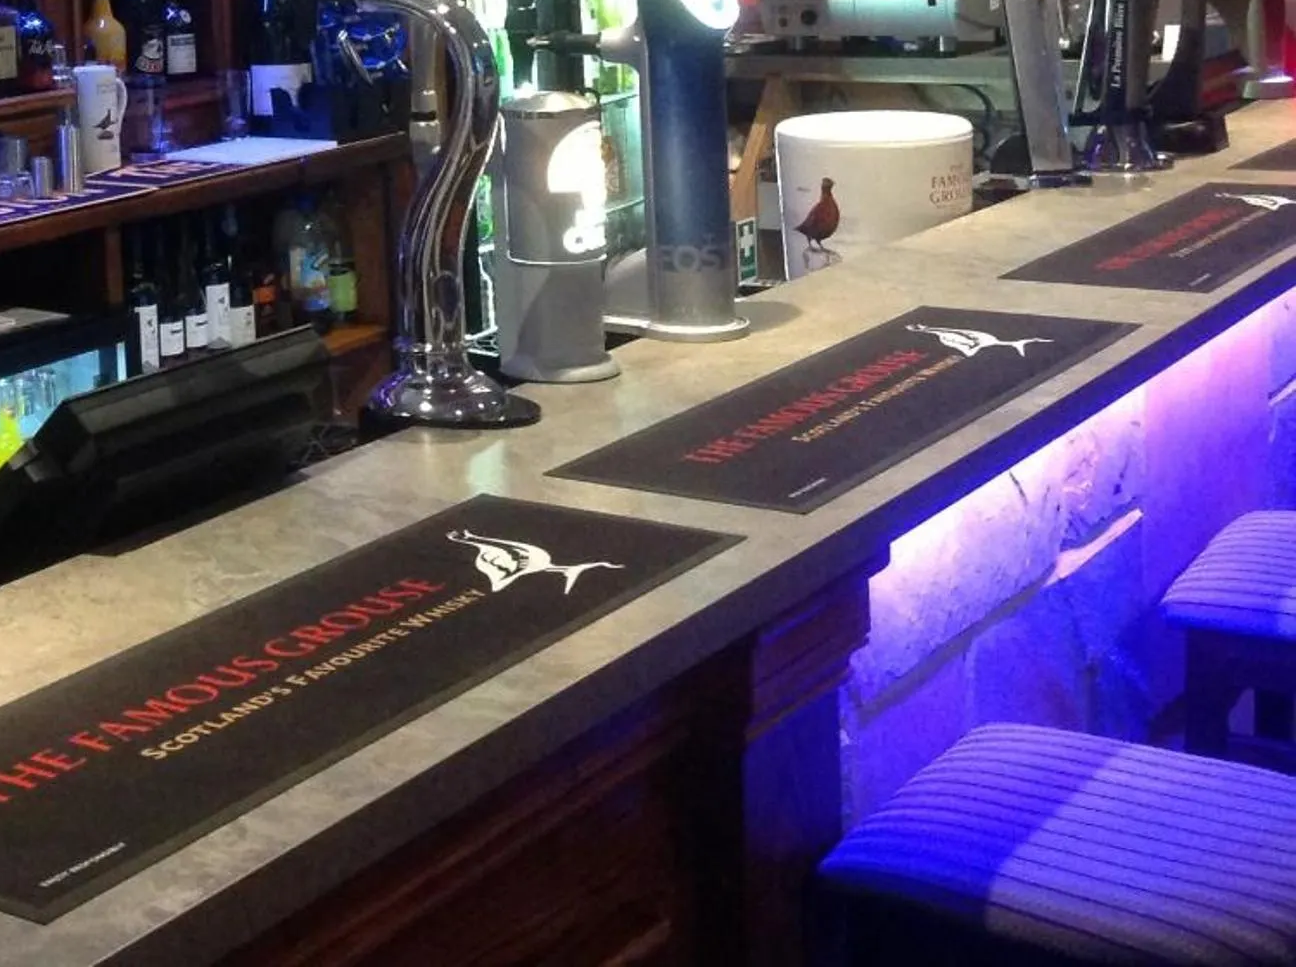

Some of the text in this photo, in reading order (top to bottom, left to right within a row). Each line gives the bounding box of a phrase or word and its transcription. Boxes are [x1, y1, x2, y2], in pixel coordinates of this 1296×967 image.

[67, 654, 279, 753] FAMOUS
[265, 577, 446, 659] GROUSE
[140, 587, 487, 760] SCOTLAND'S FAVOURITE WHISKY
